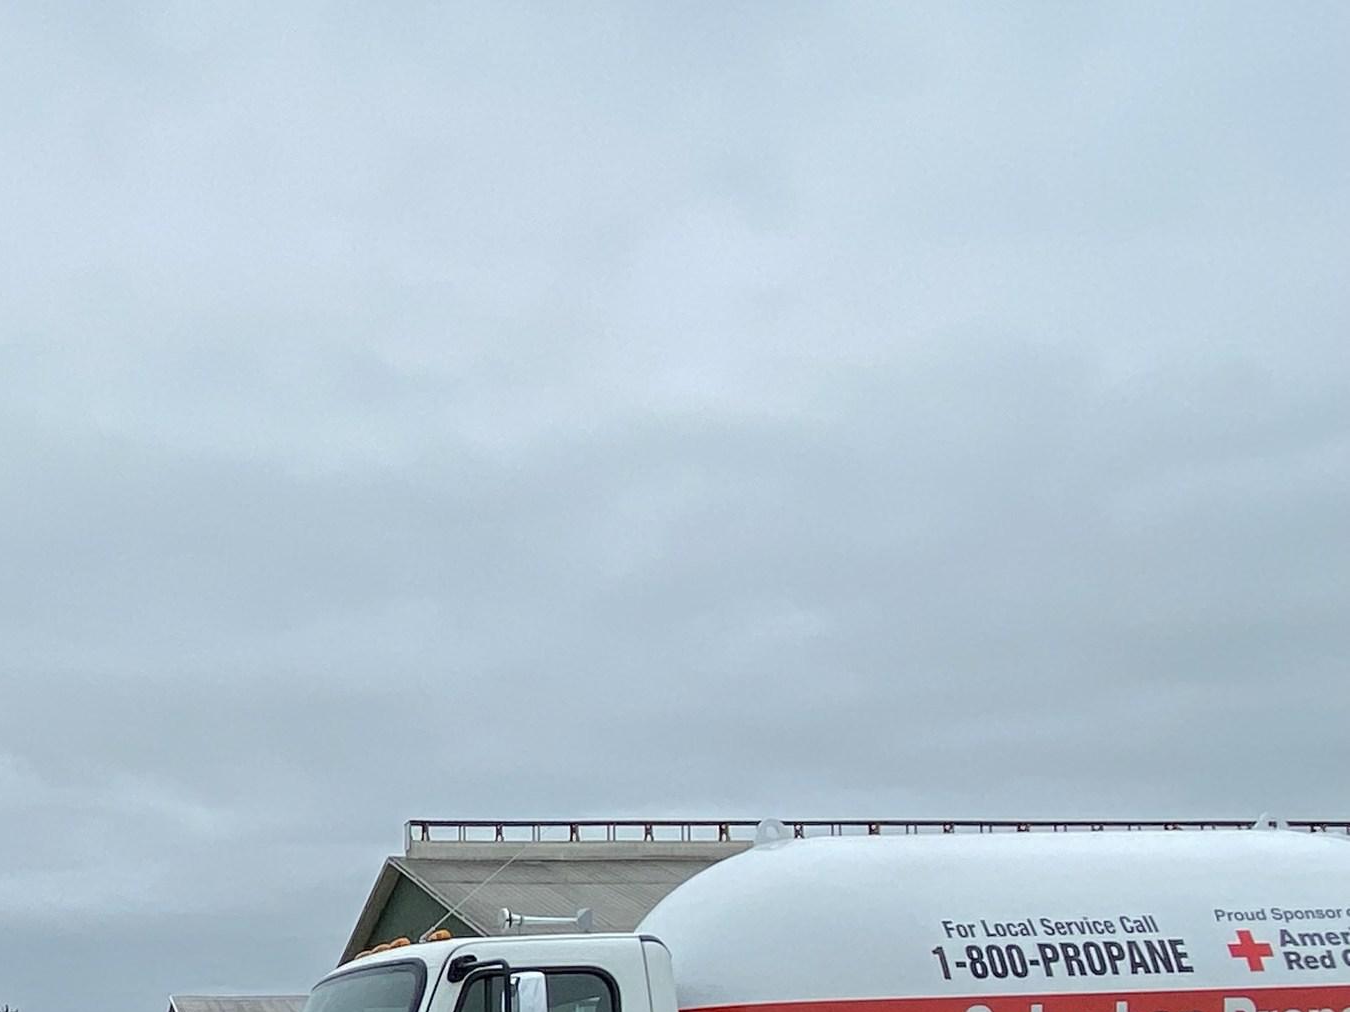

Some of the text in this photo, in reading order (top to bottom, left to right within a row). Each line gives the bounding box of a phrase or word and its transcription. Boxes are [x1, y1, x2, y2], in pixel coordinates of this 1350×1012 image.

[1214, 908, 1267, 922] Proud
[1270, 907, 1342, 923] Sponsor
[941, 915, 1160, 938] For Local Service Call
[1279, 927, 1350, 947] Amer
[931, 939, 1195, 980] 1-800-PROPANE
[1283, 949, 1337, 970] Red
